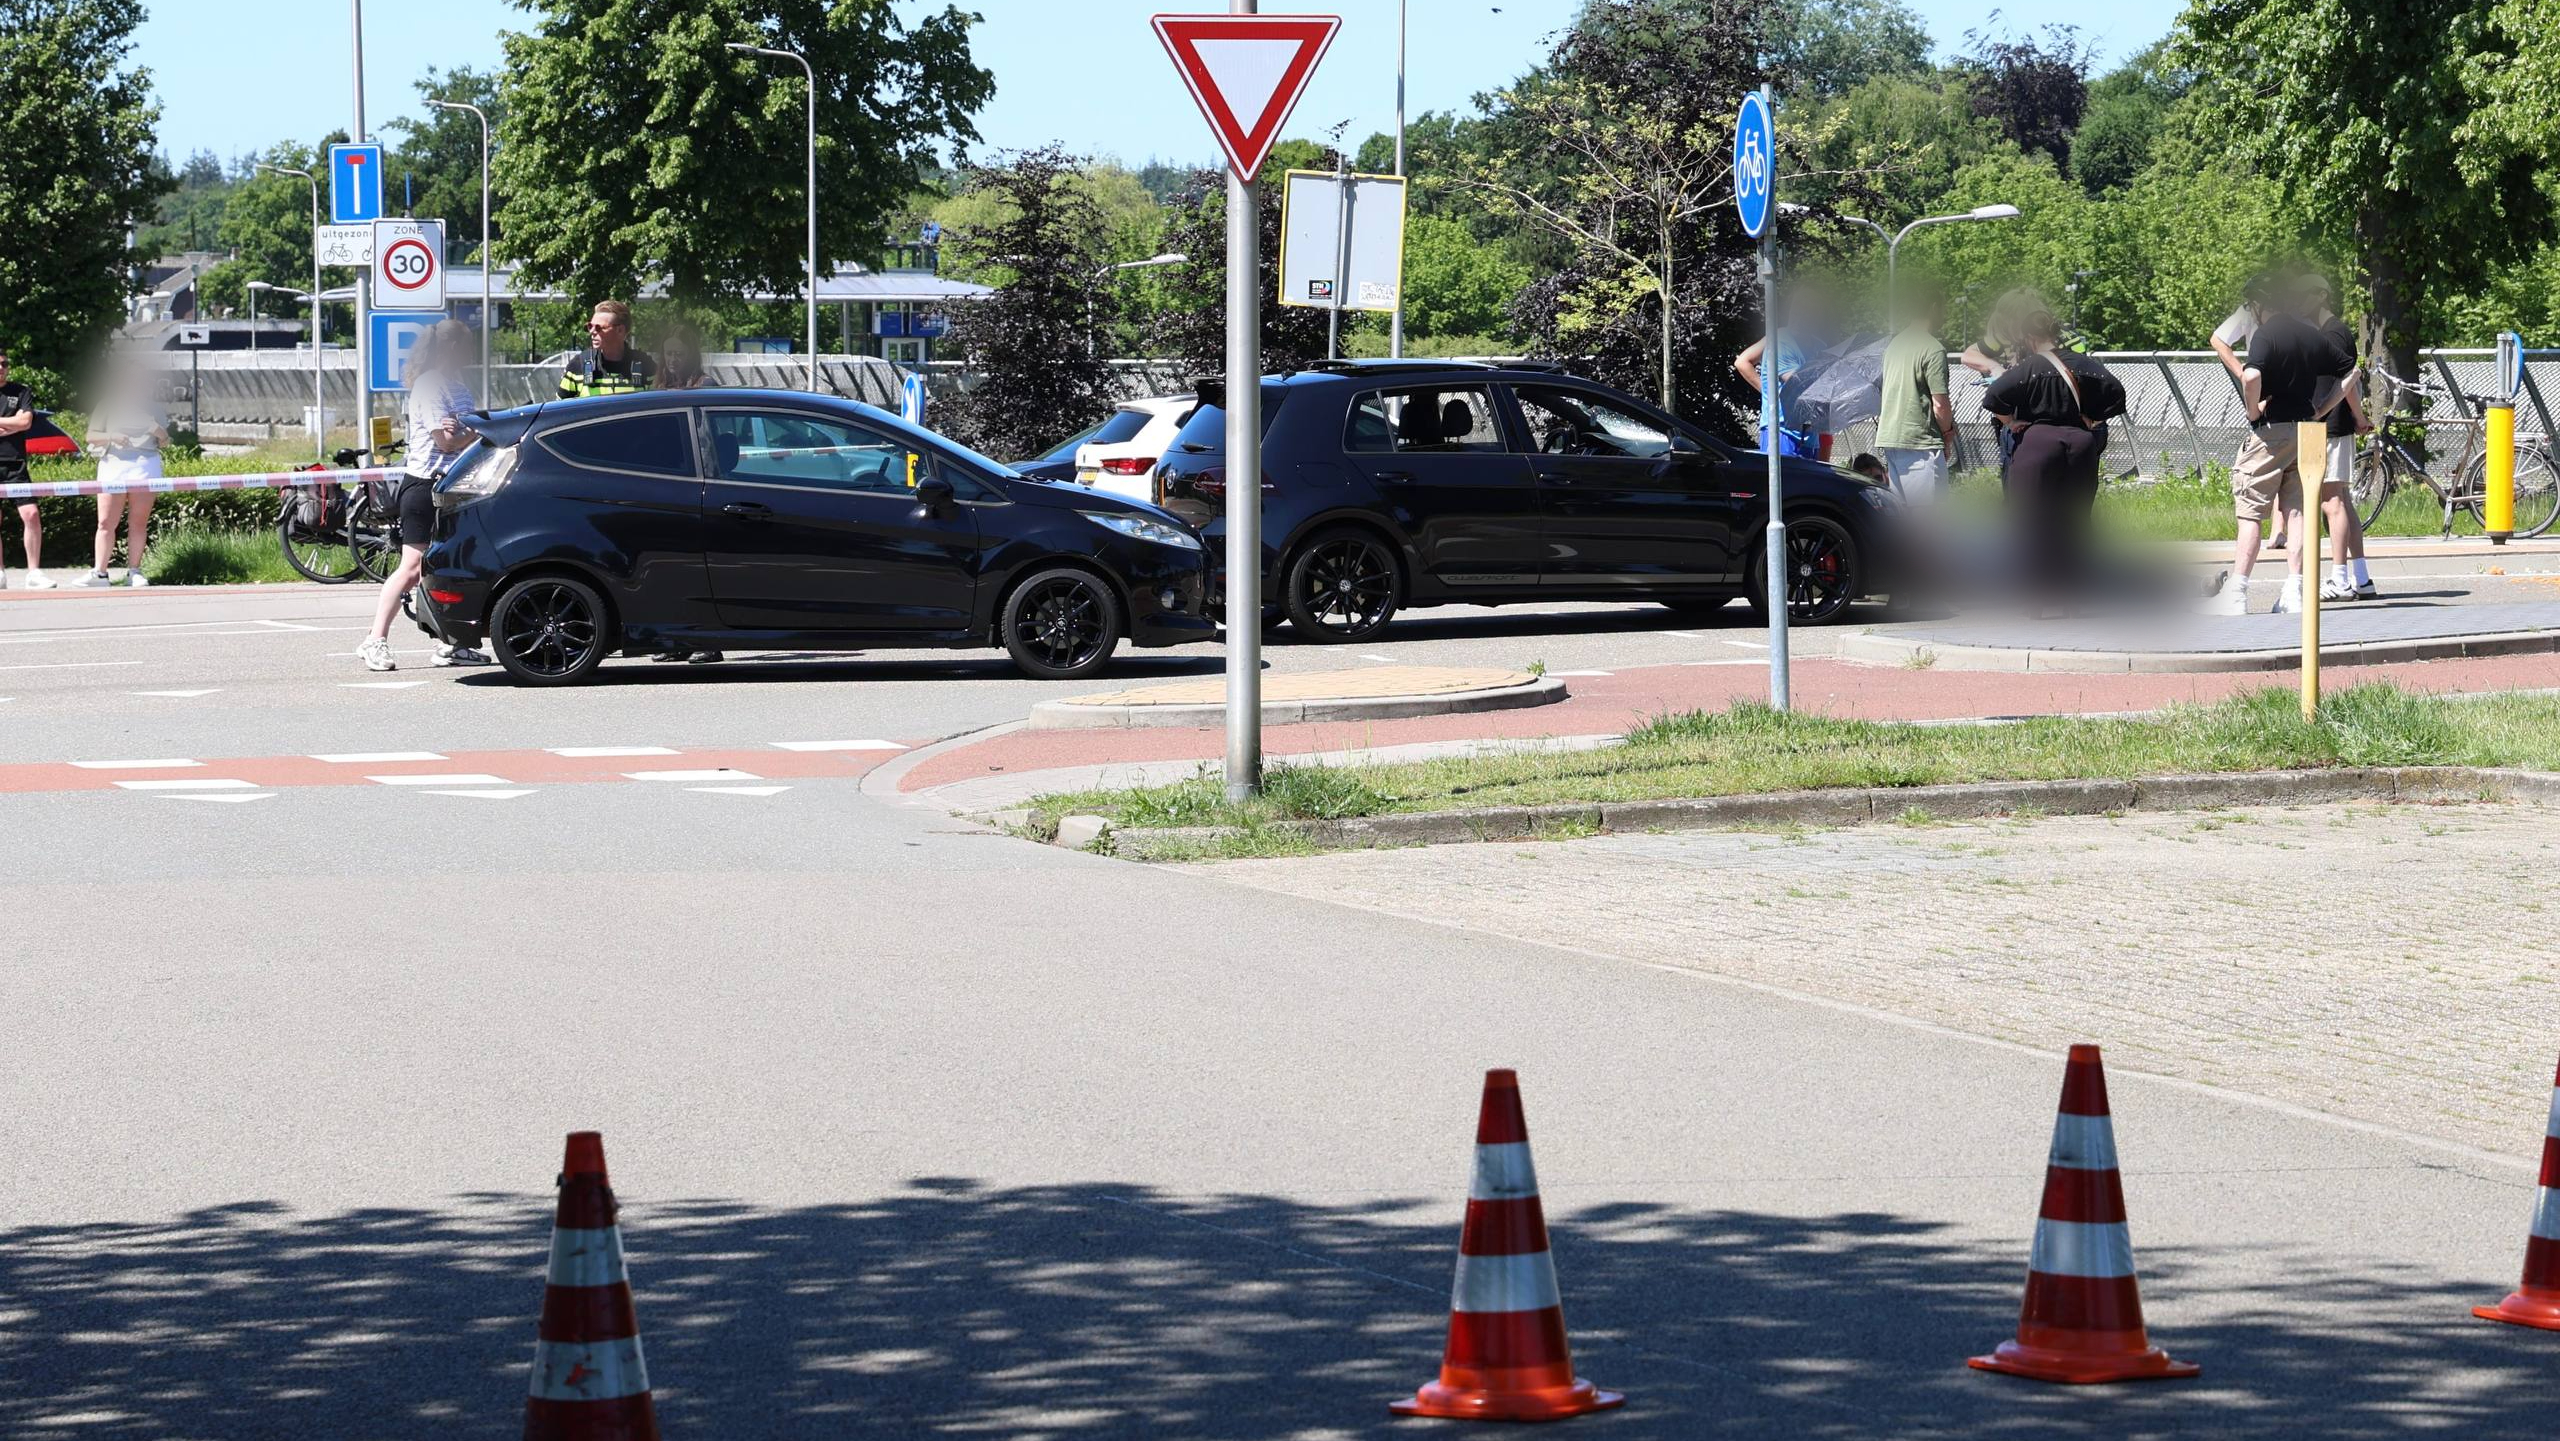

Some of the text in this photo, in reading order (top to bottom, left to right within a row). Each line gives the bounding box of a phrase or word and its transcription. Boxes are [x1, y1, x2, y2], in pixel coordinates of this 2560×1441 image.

[322, 229, 372, 240] uitgezon
[394, 226, 424, 235] ZONE
[393, 255, 425, 274] 30
[388, 322, 424, 381] P
